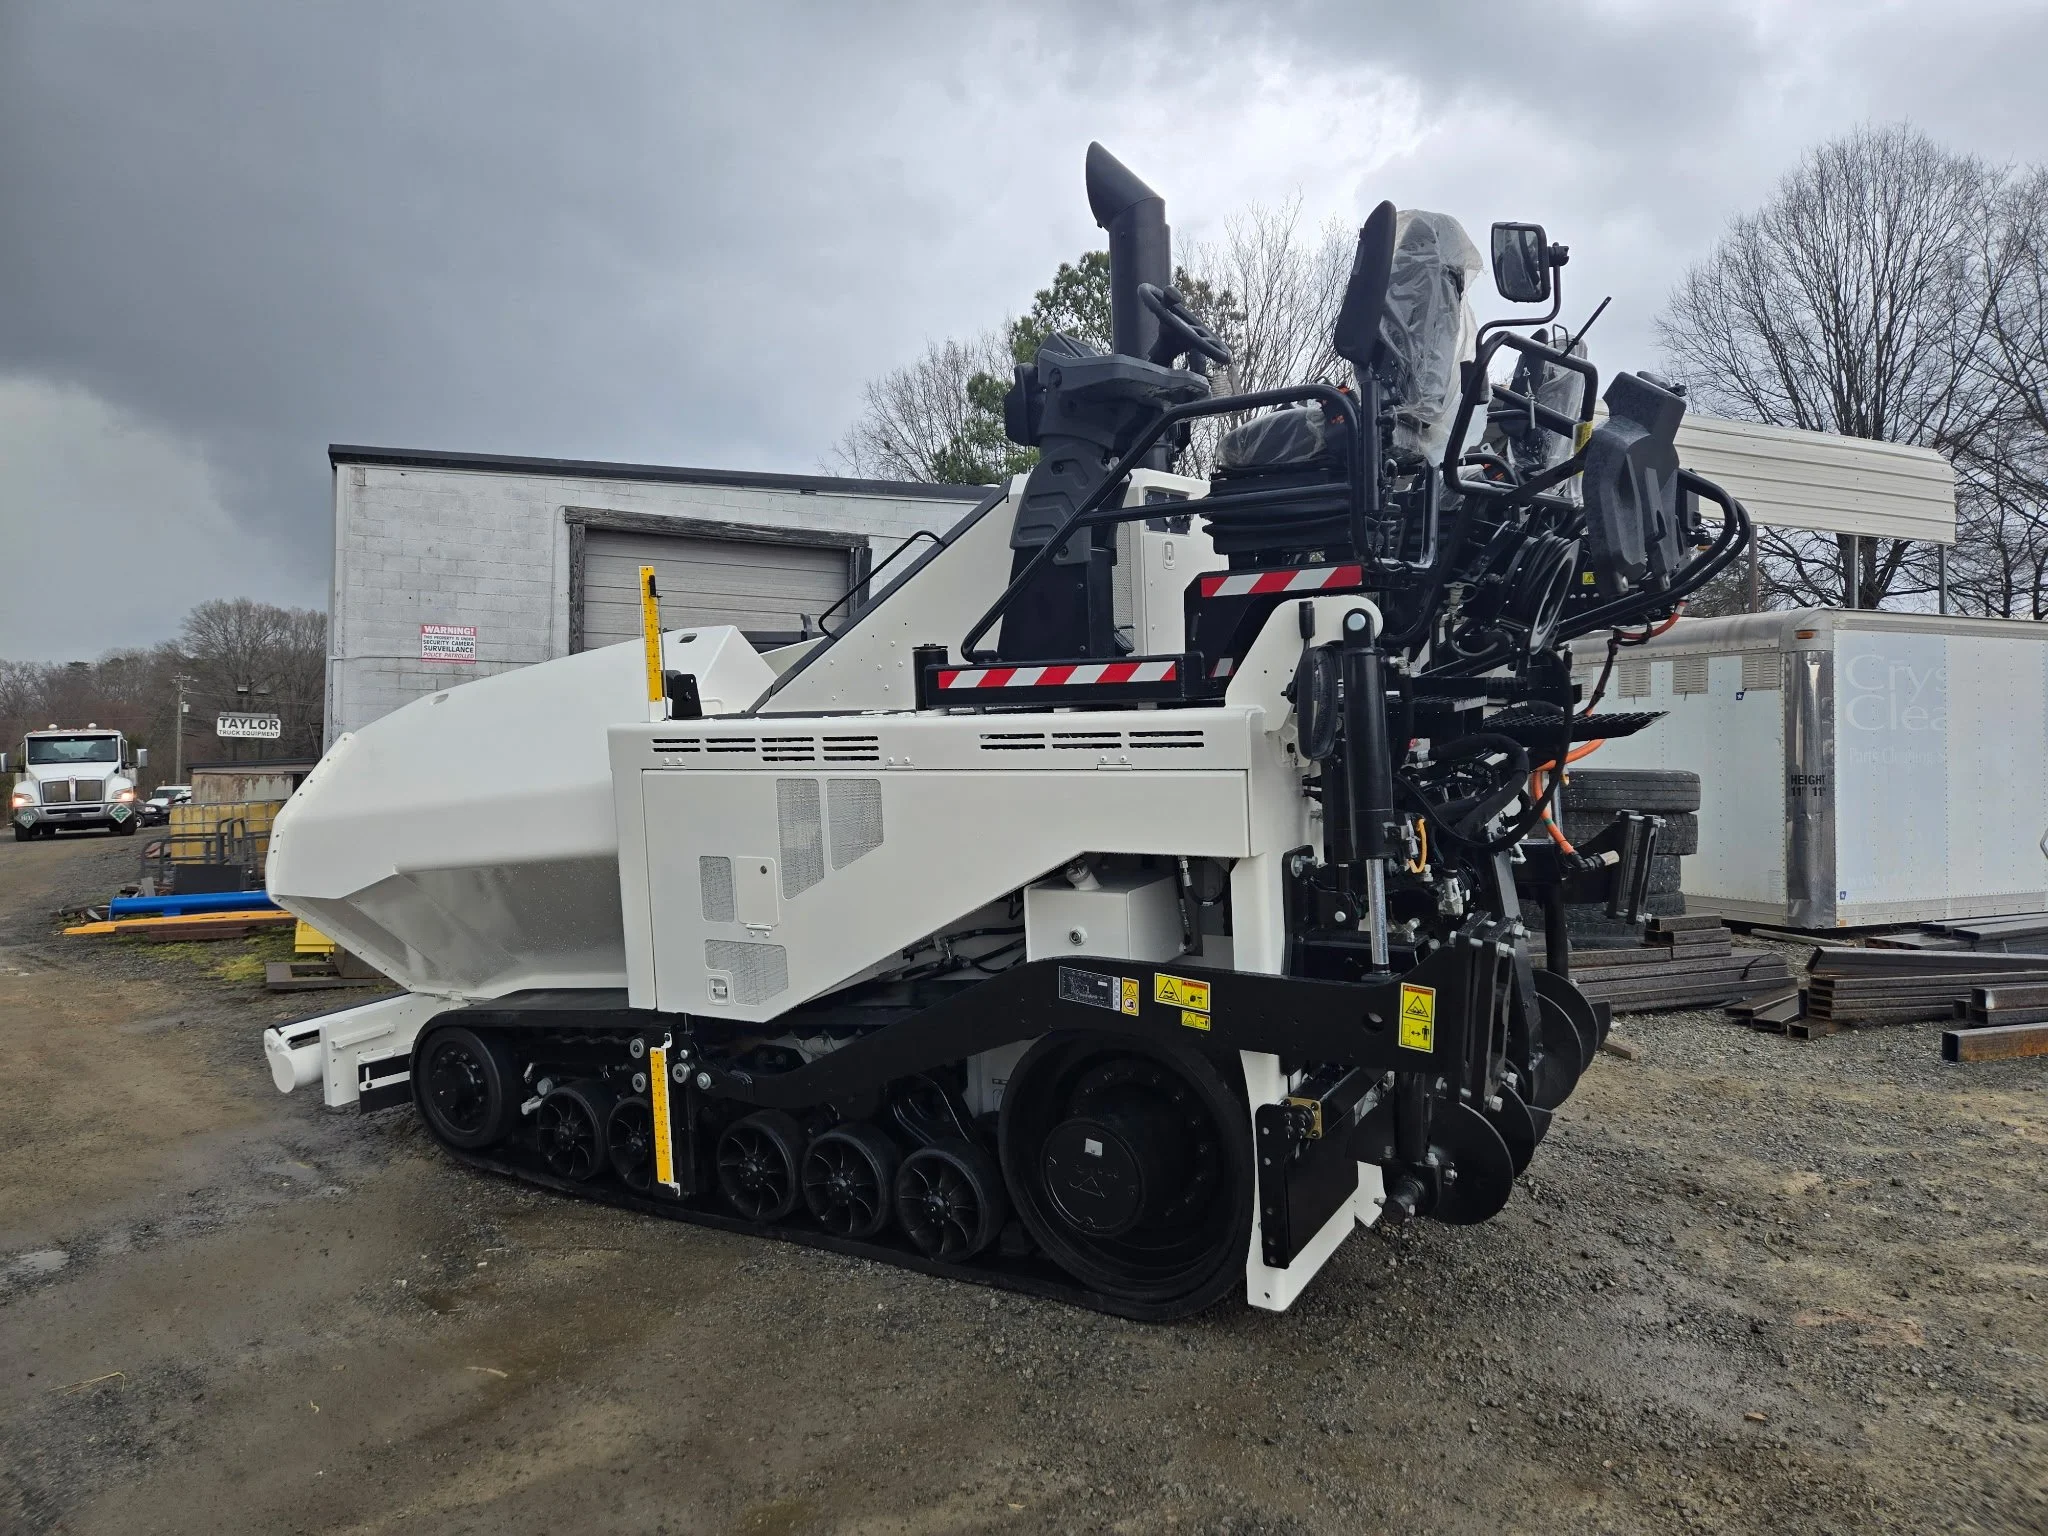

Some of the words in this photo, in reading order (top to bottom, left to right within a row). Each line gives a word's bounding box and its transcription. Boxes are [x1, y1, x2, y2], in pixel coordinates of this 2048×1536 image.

[423, 625, 474, 635] WARNING!
[423, 645, 474, 653] SURVEILLANCE
[219, 718, 279, 730] TAYLOR
[1790, 774, 1825, 786] HEIGHT
